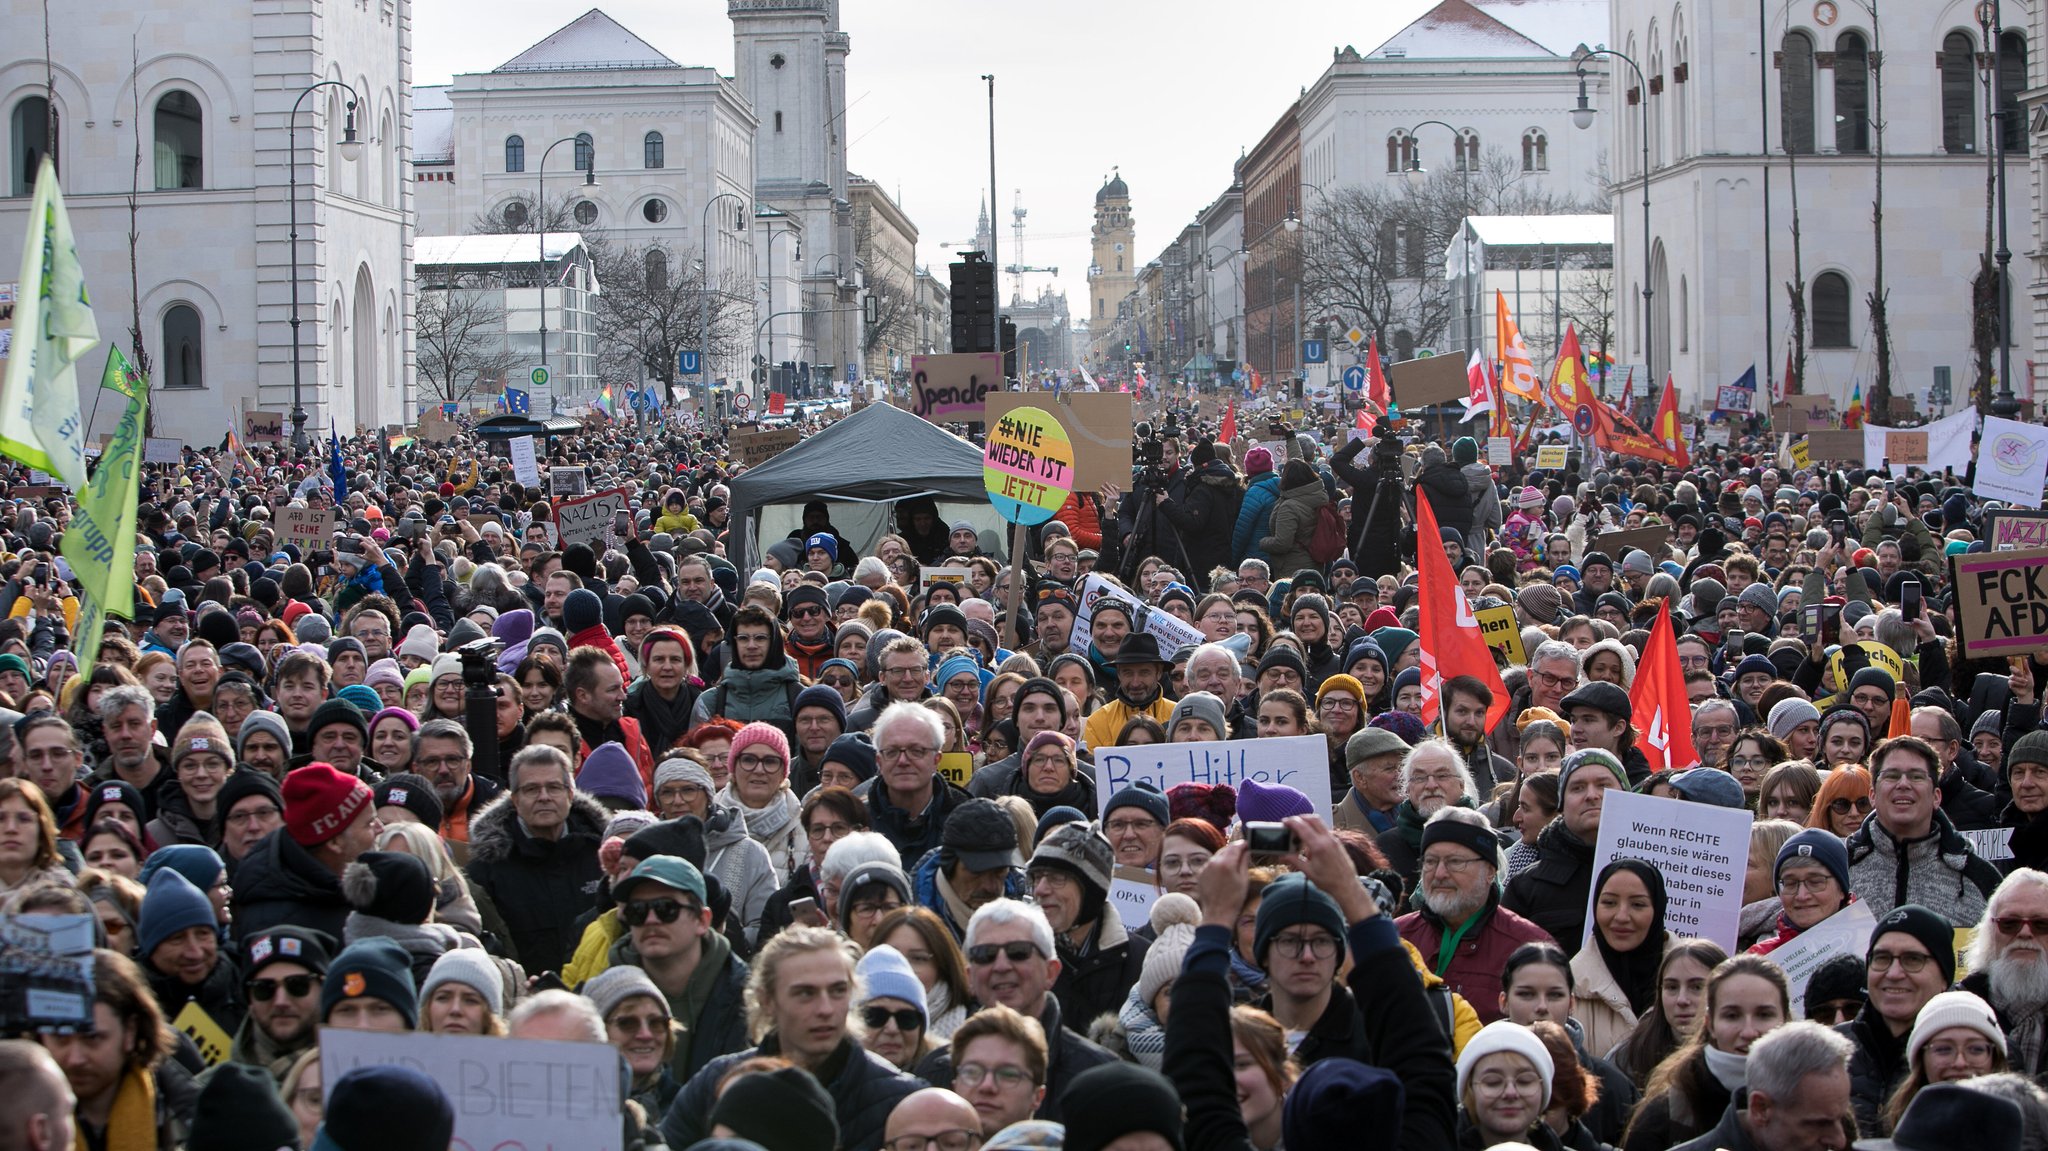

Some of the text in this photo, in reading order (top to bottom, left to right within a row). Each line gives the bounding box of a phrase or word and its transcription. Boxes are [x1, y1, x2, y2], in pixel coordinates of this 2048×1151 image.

[246, 419, 282, 439] Spenden
[999, 416, 1043, 447] #NIE
[988, 440, 1067, 481] WIEDER IST
[1001, 475, 1047, 506] JETZT
[311, 514, 325, 523] IST
[560, 500, 611, 529] NAZIS
[294, 524, 320, 535] KEINE
[1977, 564, 2048, 606] FCK
[1152, 614, 1166, 625] NIE
[1165, 621, 1194, 640] WIEDER
[1984, 602, 2048, 639] AFD
[312, 814, 338, 835] FC
[1632, 822, 1720, 846] Wenn RECHTE
[1617, 837, 1729, 864] glauben, sie wären
[1977, 829, 2009, 860] PEOPLE
[1666, 877, 1724, 896] haben sie
[1692, 866, 1731, 881] dieses
[1116, 889, 1145, 904] OPAS
[1667, 896, 1701, 909] nur in
[1784, 946, 1807, 963] VIELFALT
[1786, 944, 1831, 973] MENSCHLICHKEIT
[460, 1059, 618, 1120] BIETEN
